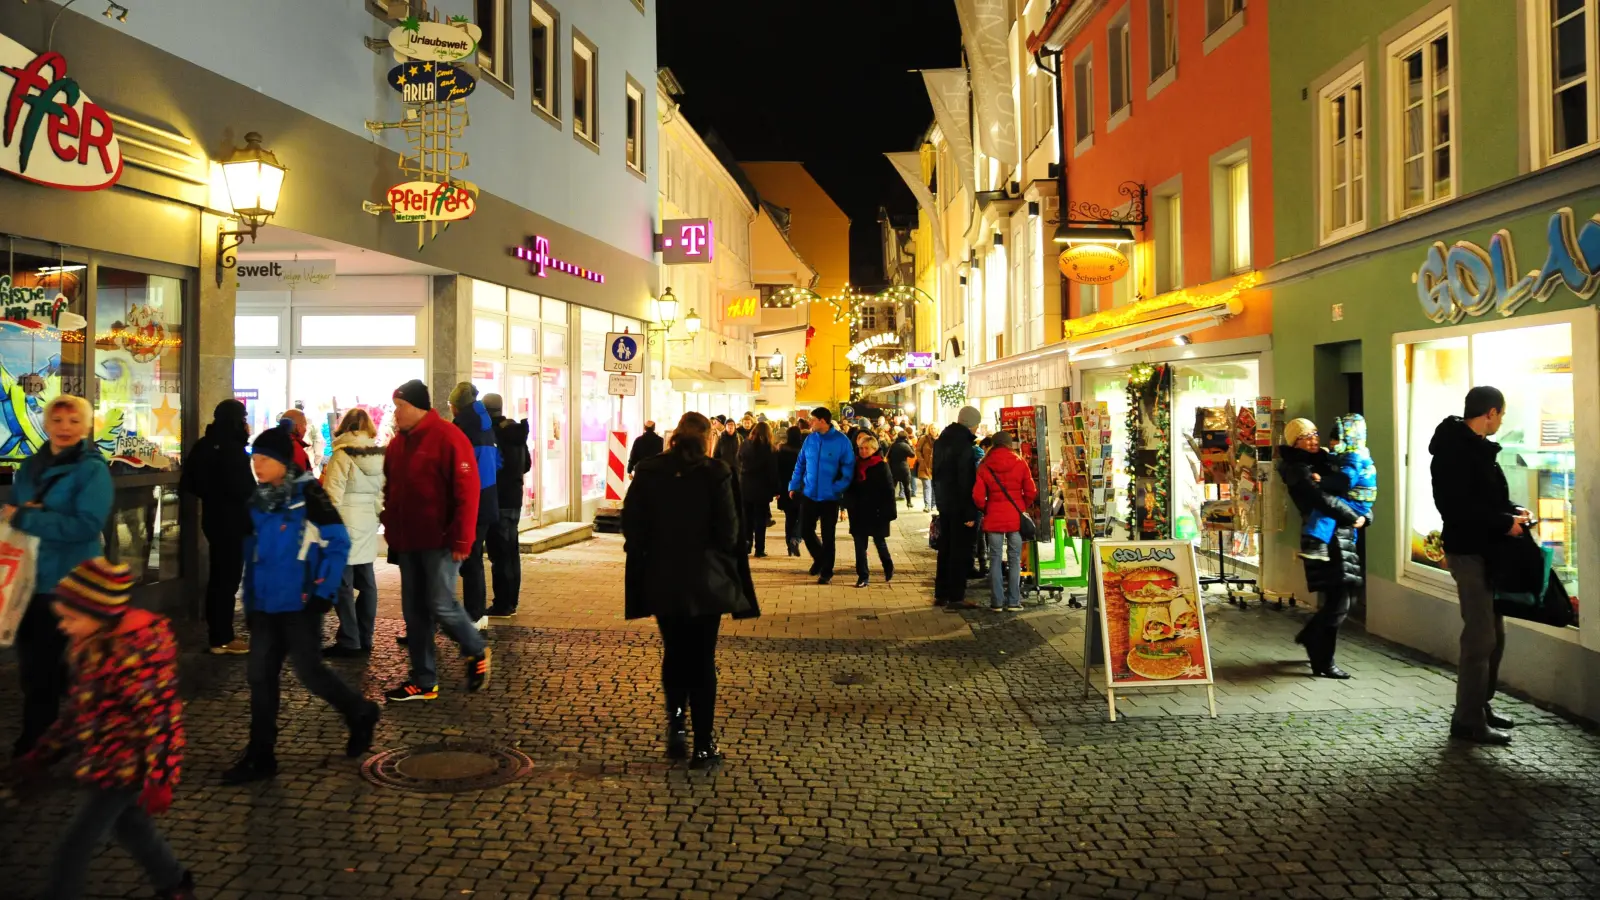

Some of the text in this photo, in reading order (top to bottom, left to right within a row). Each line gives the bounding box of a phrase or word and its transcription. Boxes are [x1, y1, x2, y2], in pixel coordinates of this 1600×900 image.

[410, 34, 468, 51] Urlaubswelt
[403, 82, 434, 102] ARILA
[681, 226, 706, 255] T
[535, 235, 549, 278] T
[1062, 248, 1126, 266] Buchhandlung
[237, 262, 282, 277] swelt
[1076, 273, 1112, 282] Schreiber
[613, 362, 633, 370] ZONE
[1112, 547, 1176, 563] GOLAN
